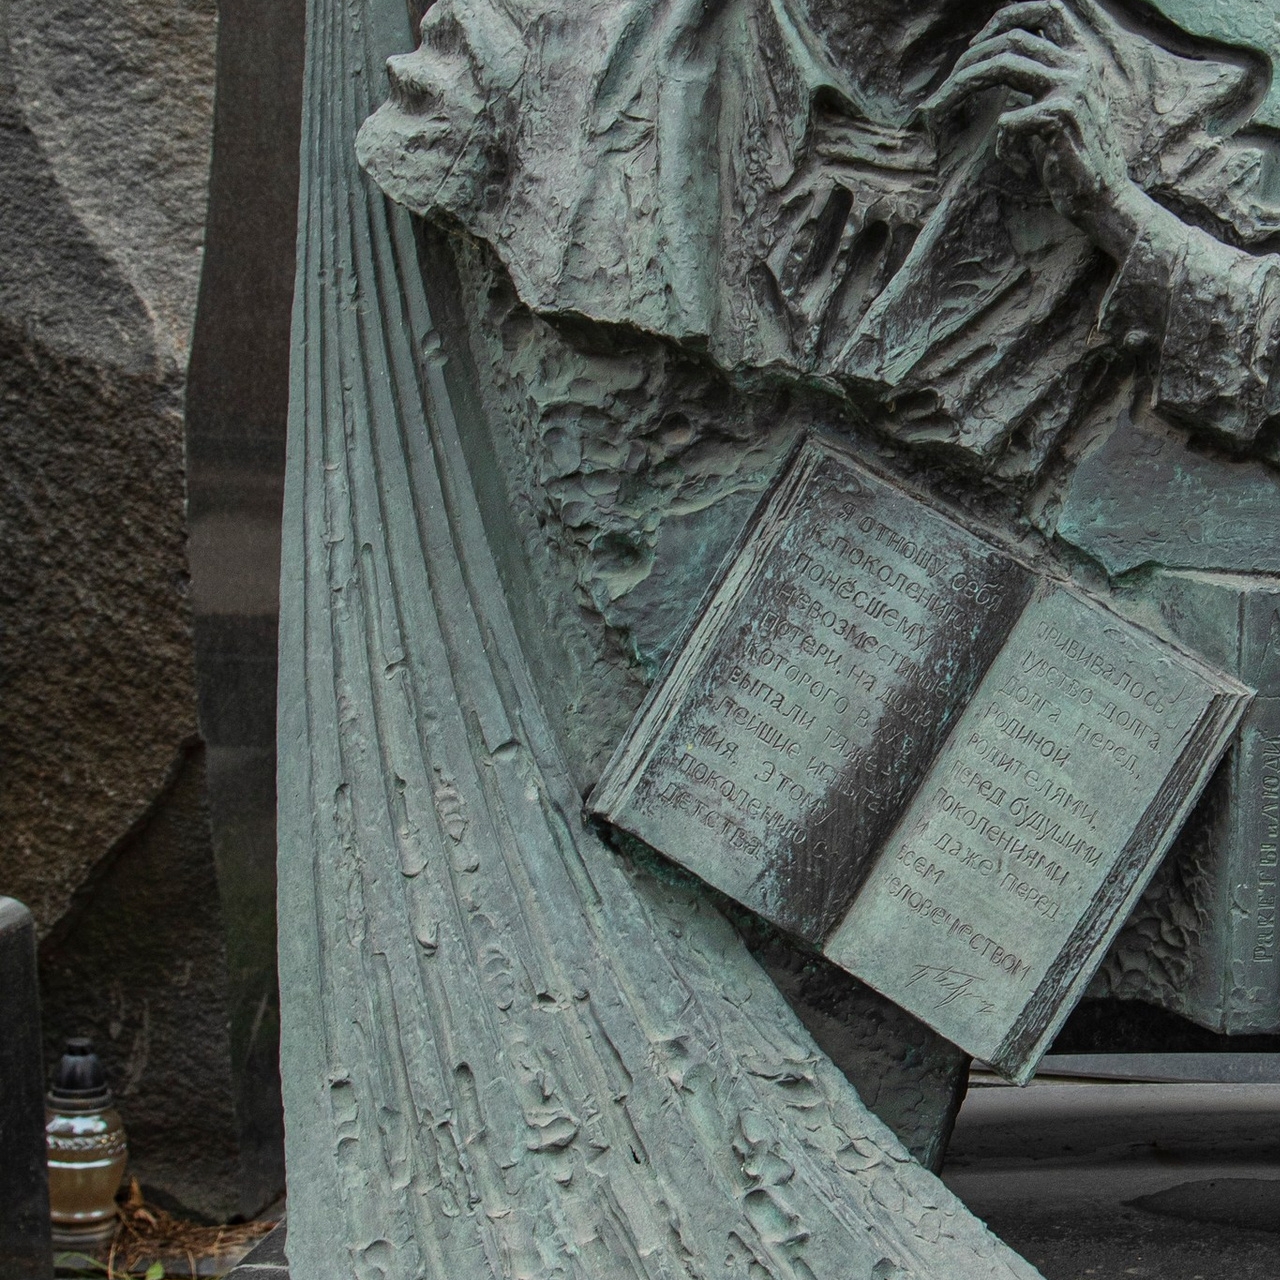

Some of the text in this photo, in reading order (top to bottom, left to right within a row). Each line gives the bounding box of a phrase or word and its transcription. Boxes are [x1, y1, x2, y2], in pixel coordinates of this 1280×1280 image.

[726, 665, 816, 731] выпали
[845, 663, 878, 693] на
[675, 751, 811, 847] поколению
[748, 758, 839, 830] Этому
